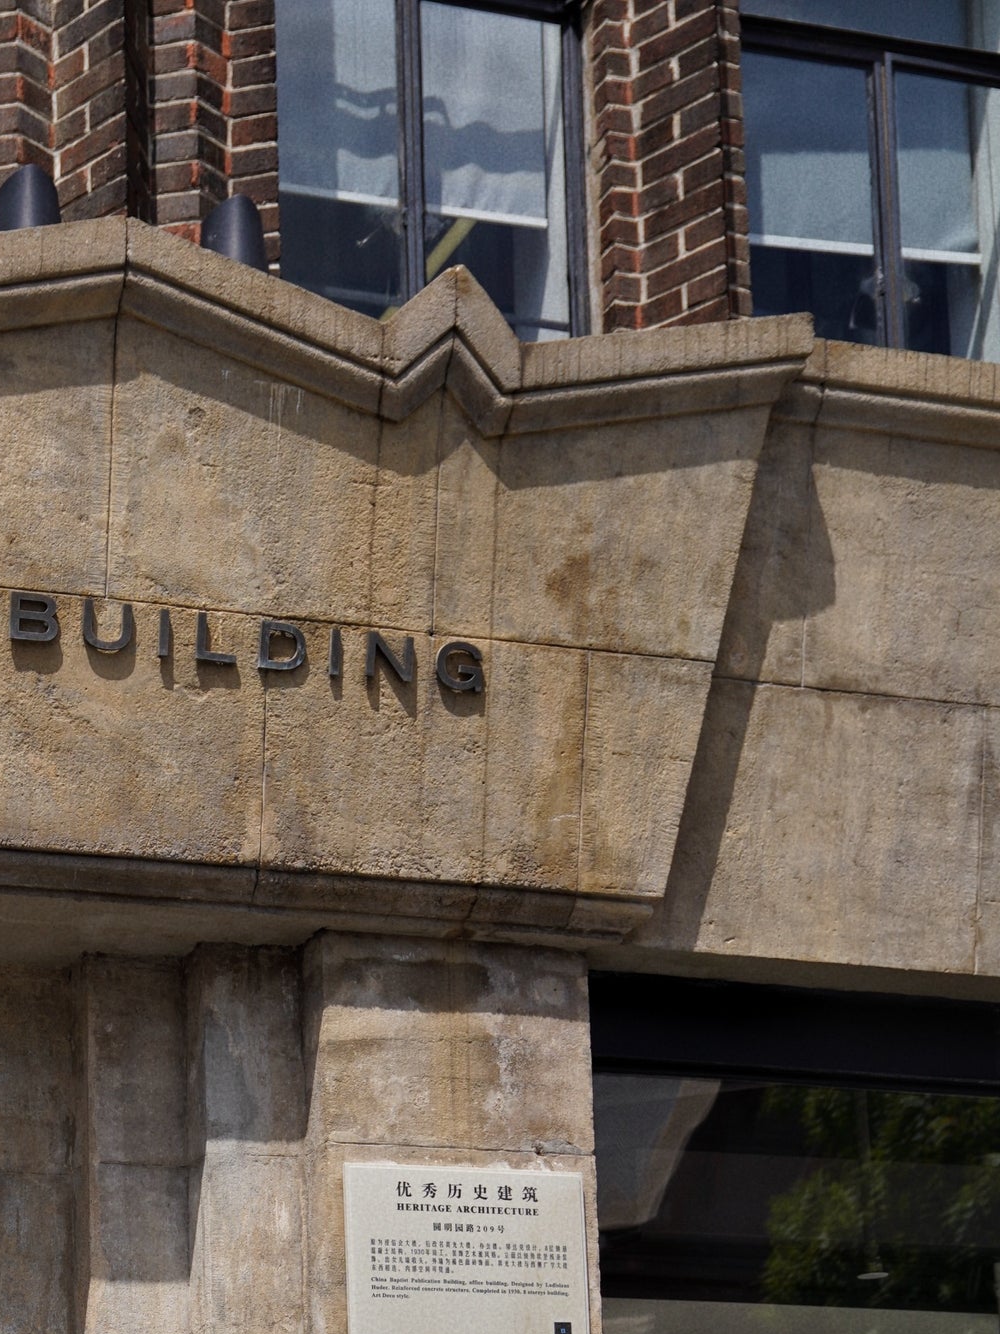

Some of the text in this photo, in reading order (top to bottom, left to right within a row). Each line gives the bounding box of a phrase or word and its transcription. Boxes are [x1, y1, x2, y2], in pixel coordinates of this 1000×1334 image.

[9, 591, 483, 693] BUILDING
[396, 1180, 539, 1203] 优秀历史建筑
[396, 1202, 540, 1216] HERITAGE ARCHITECTURE
